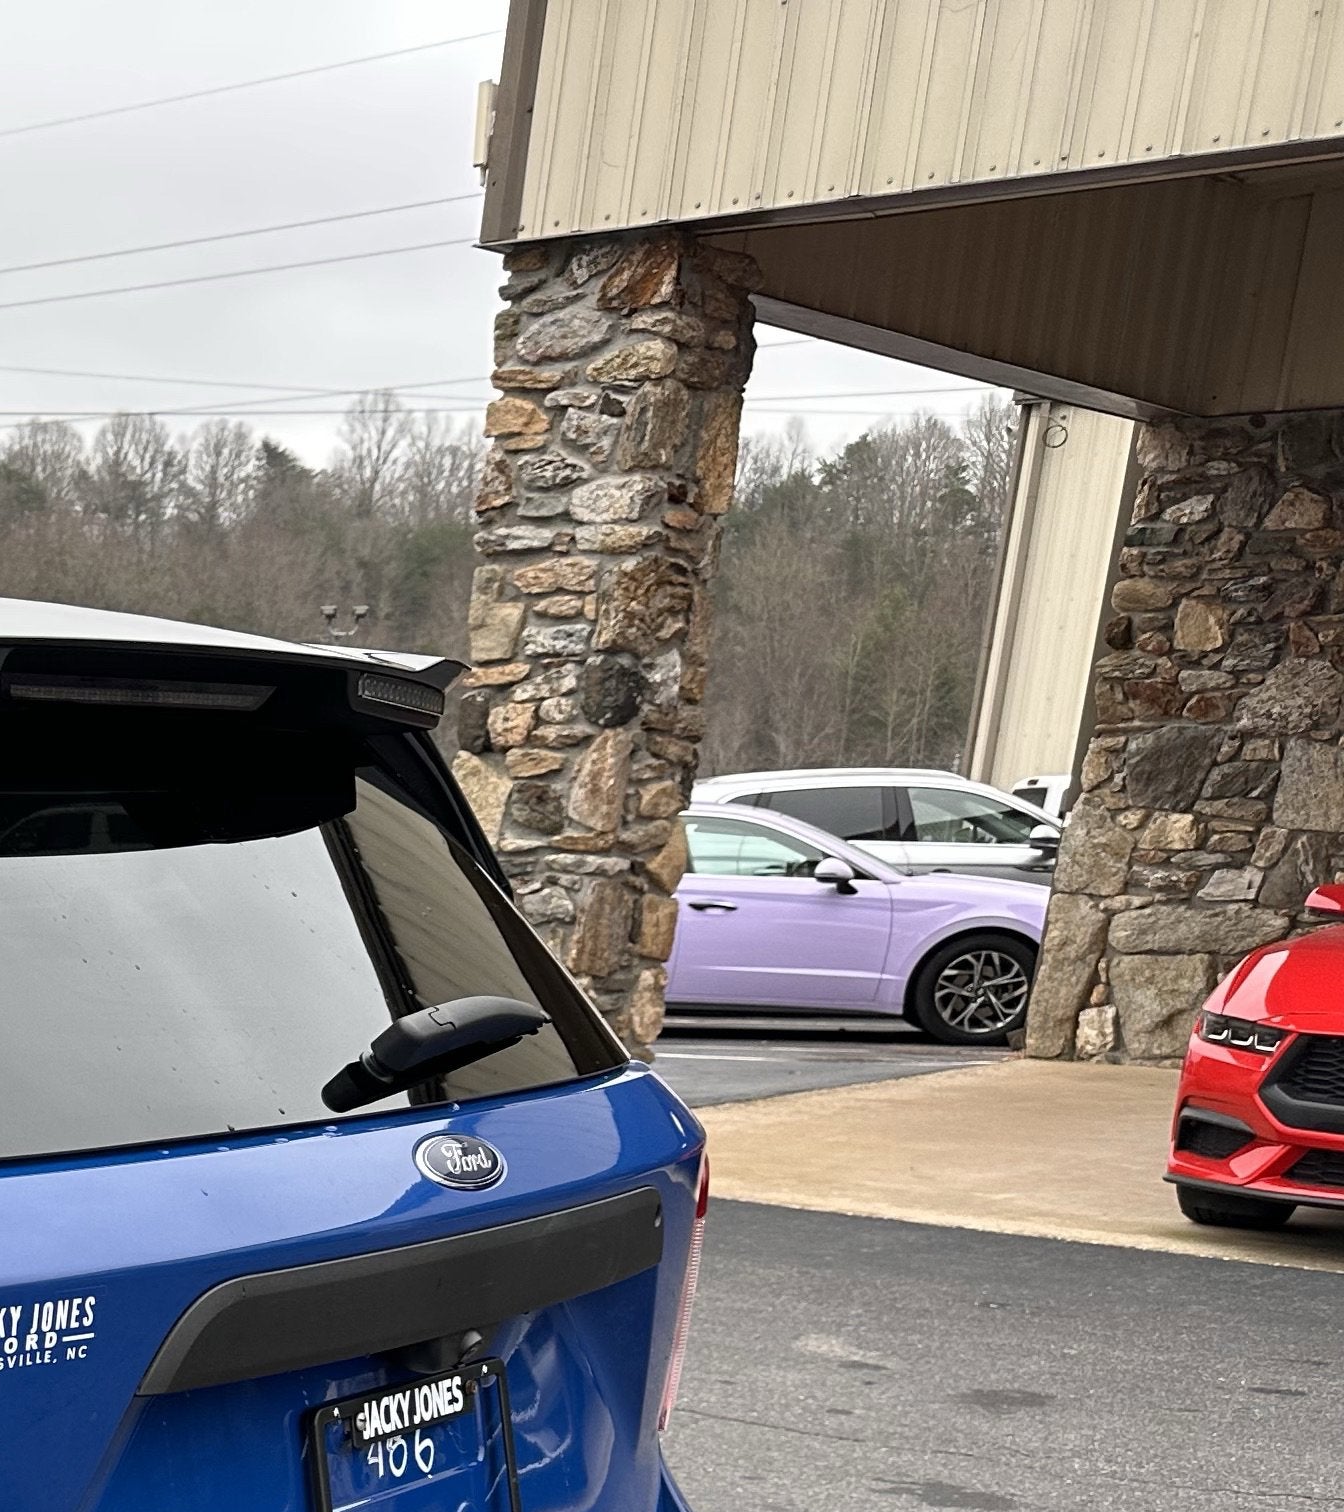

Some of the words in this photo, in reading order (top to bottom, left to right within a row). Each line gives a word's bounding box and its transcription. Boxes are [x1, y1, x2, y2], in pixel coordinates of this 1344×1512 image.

[440, 1142, 492, 1175] Ford
[29, 1295, 96, 1335] JONES
[65, 1345, 88, 1361] NC
[362, 1389, 411, 1440] JACKY
[413, 1375, 464, 1425] JONES
